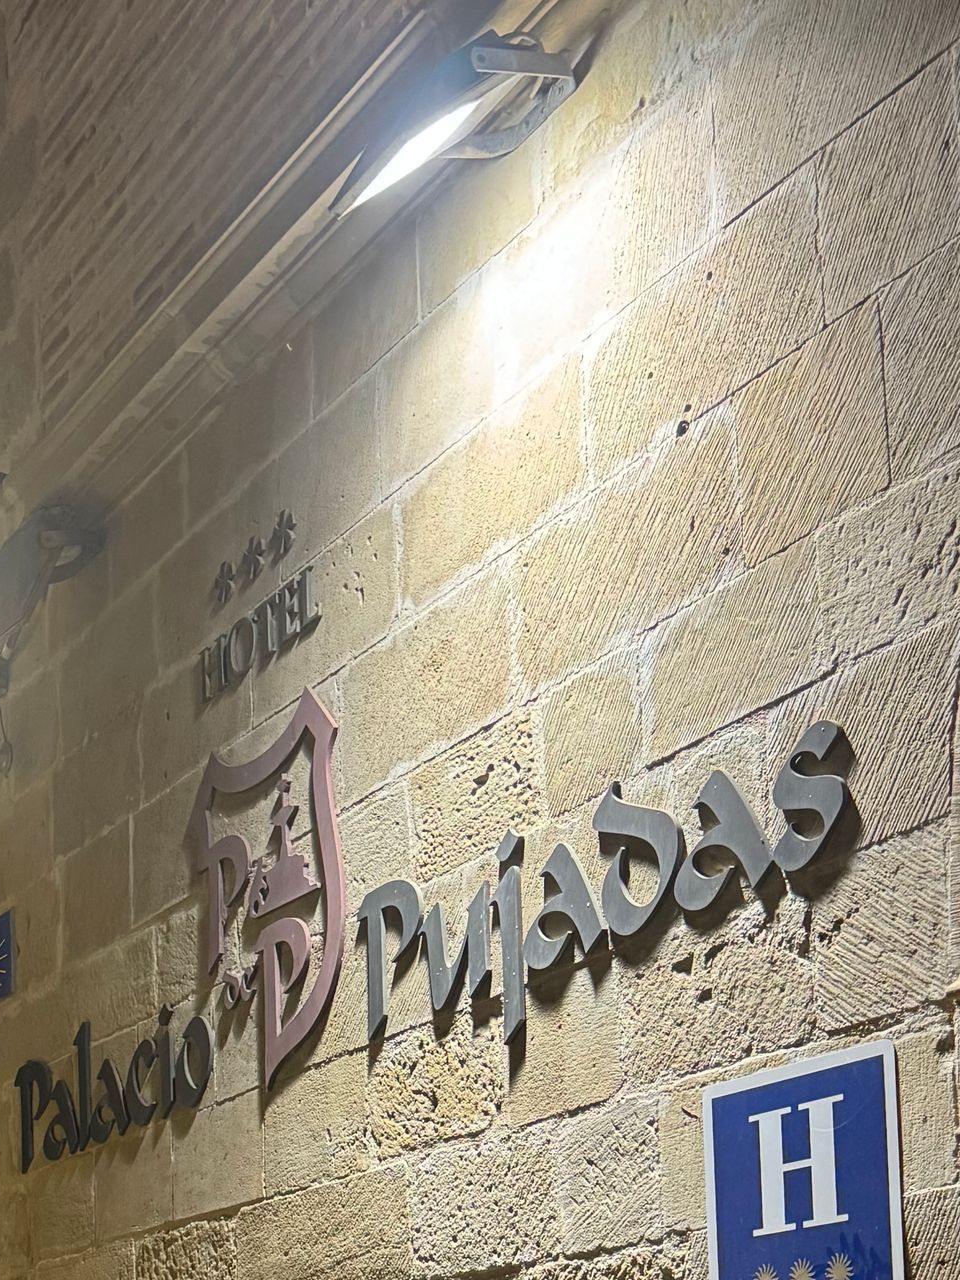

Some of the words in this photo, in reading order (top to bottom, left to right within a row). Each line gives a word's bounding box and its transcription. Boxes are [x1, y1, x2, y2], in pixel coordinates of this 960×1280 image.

[198, 566, 323, 699] HOTEL
[14, 1002, 216, 1174] Palacio
[357, 719, 845, 1045] Pujadas
[748, 1093, 849, 1238] H
